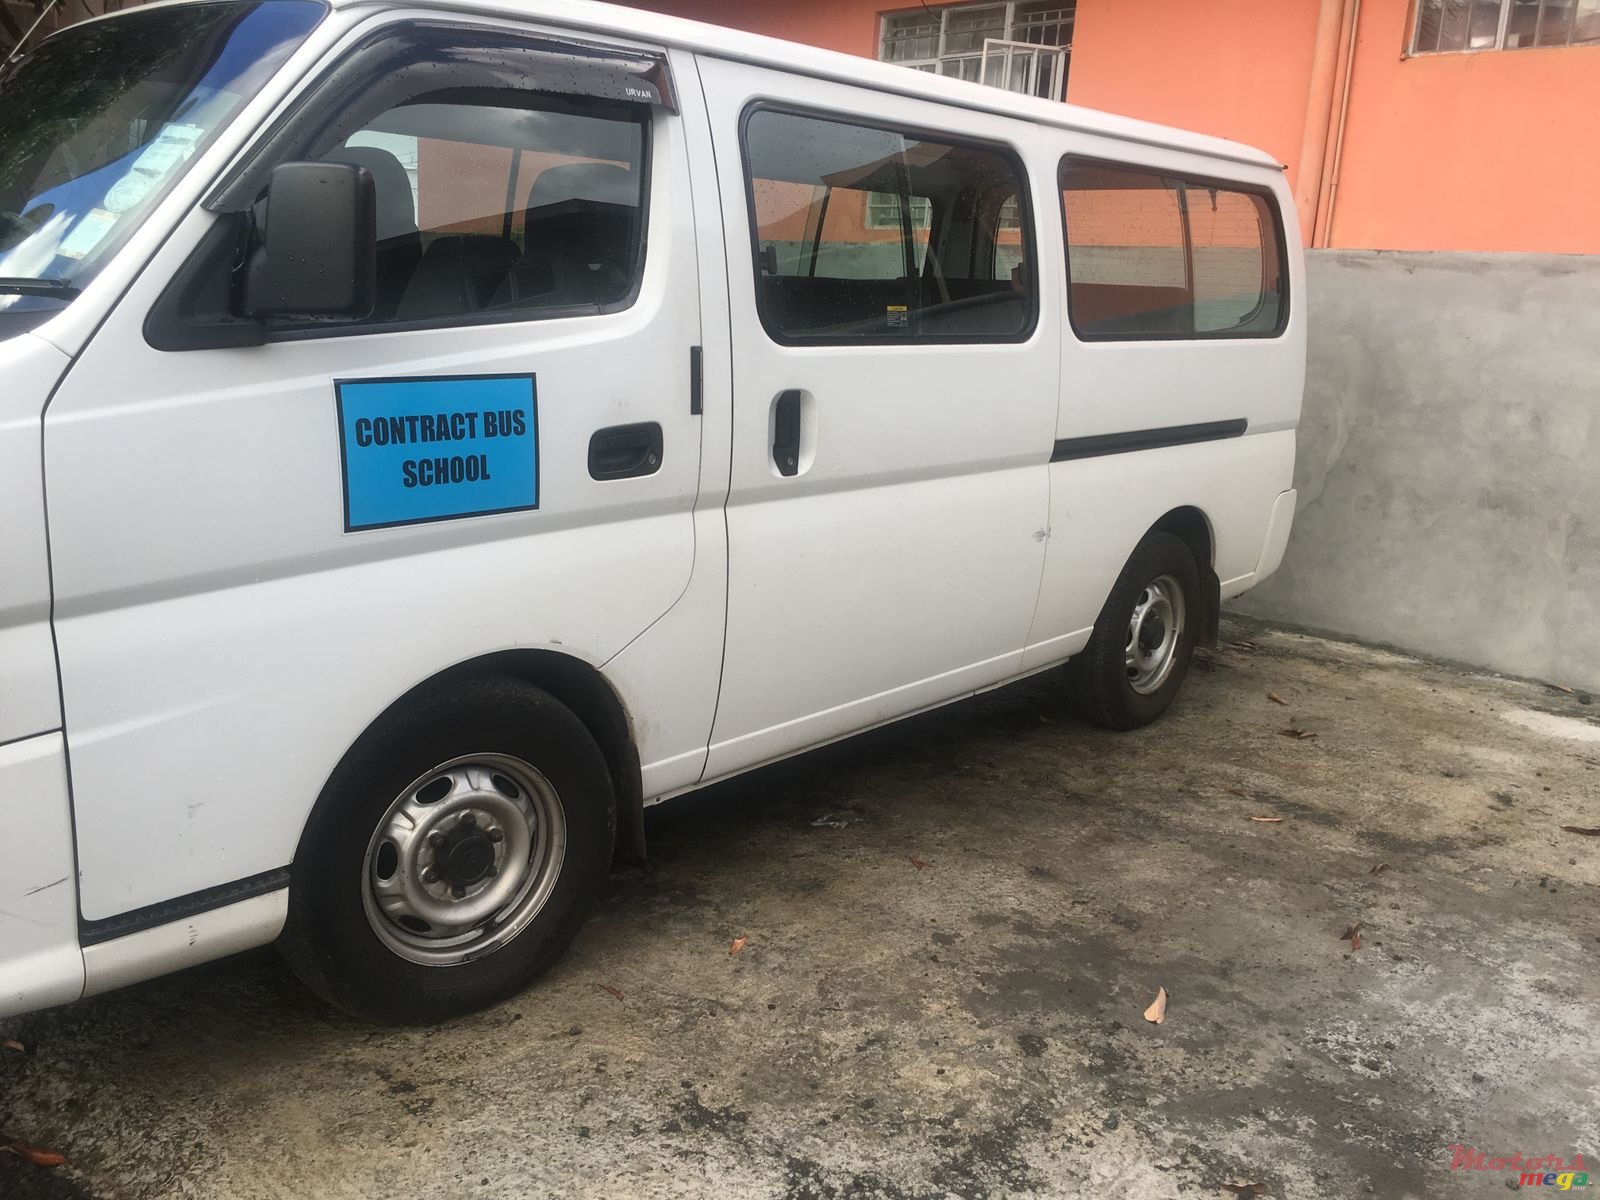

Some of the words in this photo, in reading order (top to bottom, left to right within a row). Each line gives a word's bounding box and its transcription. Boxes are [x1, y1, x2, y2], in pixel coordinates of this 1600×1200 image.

[625, 88, 652, 99] URVAN
[355, 412, 478, 448] CONTRACT
[483, 409, 526, 438] BUS
[402, 454, 490, 488] SCHOOL
